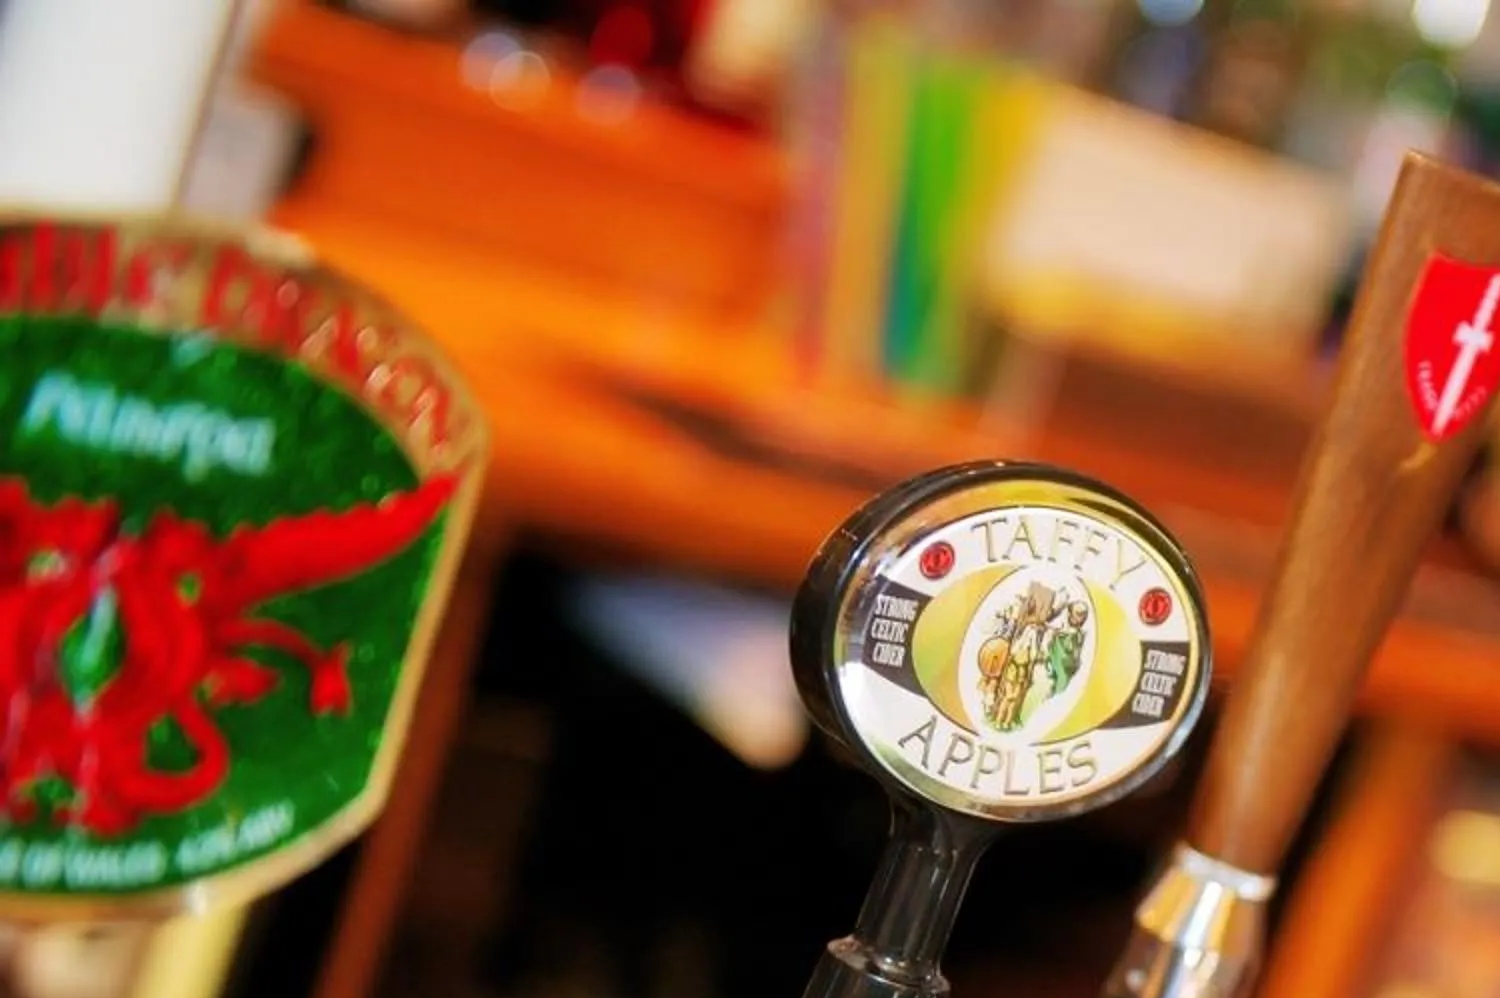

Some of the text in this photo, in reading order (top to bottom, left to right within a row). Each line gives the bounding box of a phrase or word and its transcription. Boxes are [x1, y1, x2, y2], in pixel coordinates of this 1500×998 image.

[970, 515, 1154, 591] TAFFY
[875, 593, 919, 622] STRONG
[871, 618, 909, 643] CELTIC
[872, 641, 905, 668] CIDER
[1143, 649, 1186, 676] STRONG
[1132, 692, 1165, 718] CIDER
[898, 715, 1098, 796] APPLES
